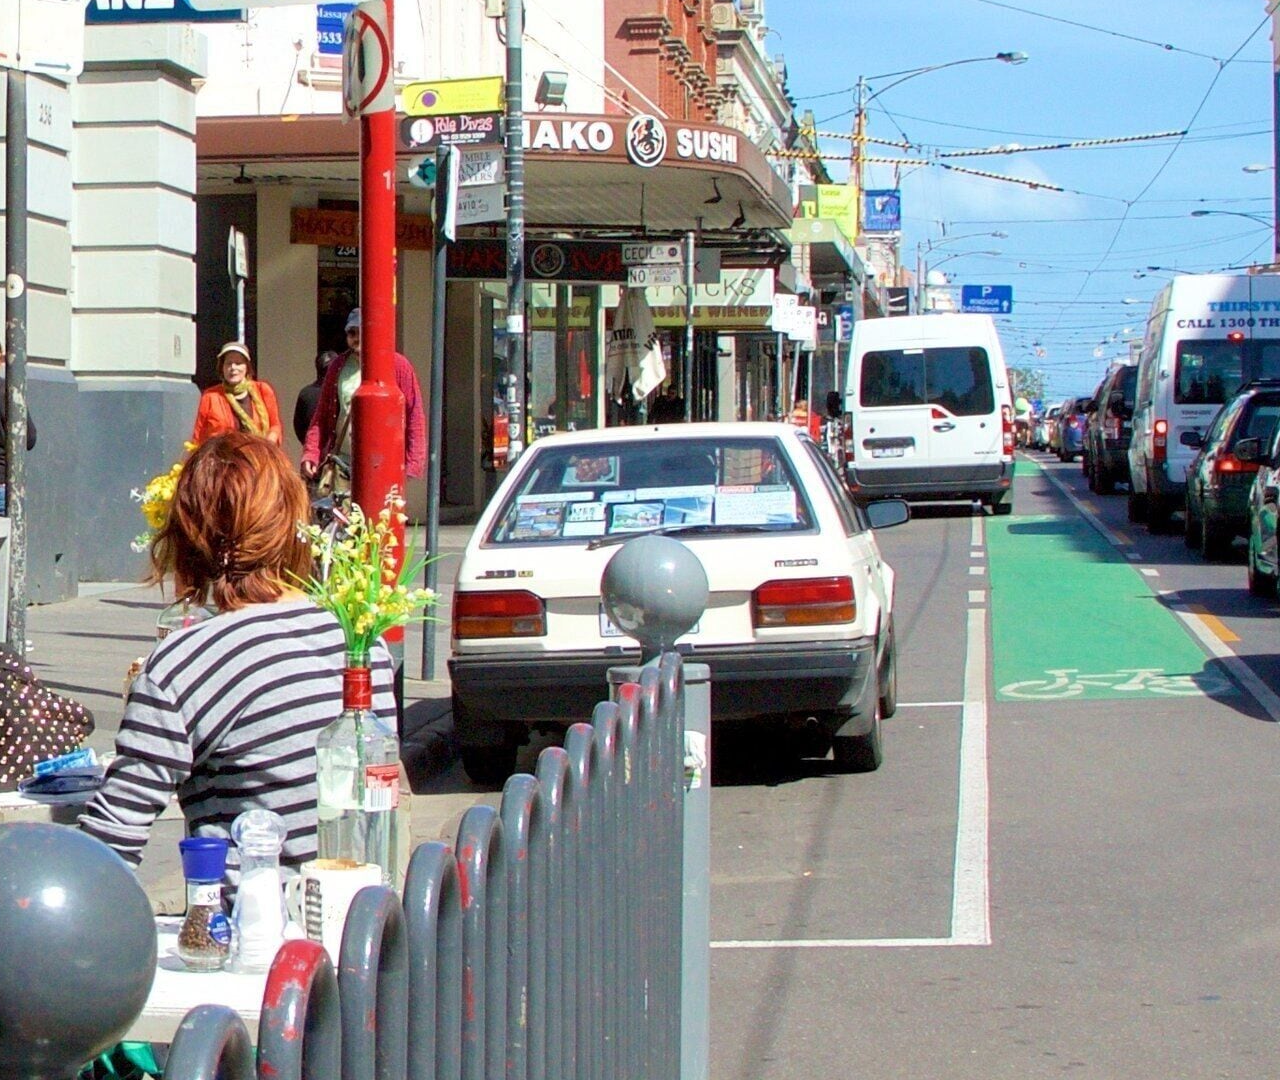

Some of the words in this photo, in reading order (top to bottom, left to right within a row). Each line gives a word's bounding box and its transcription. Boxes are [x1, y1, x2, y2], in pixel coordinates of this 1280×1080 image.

[434, 116, 456, 134] Pole
[459, 115, 493, 131] Divas
[676, 128, 738, 163] SUSHI
[338, 245, 357, 256] 234
[624, 246, 656, 260] CECIL
[630, 270, 646, 283] NO
[982, 286, 992, 297] P
[1177, 318, 1215, 328] CALL
[1220, 318, 1255, 328] 1300
